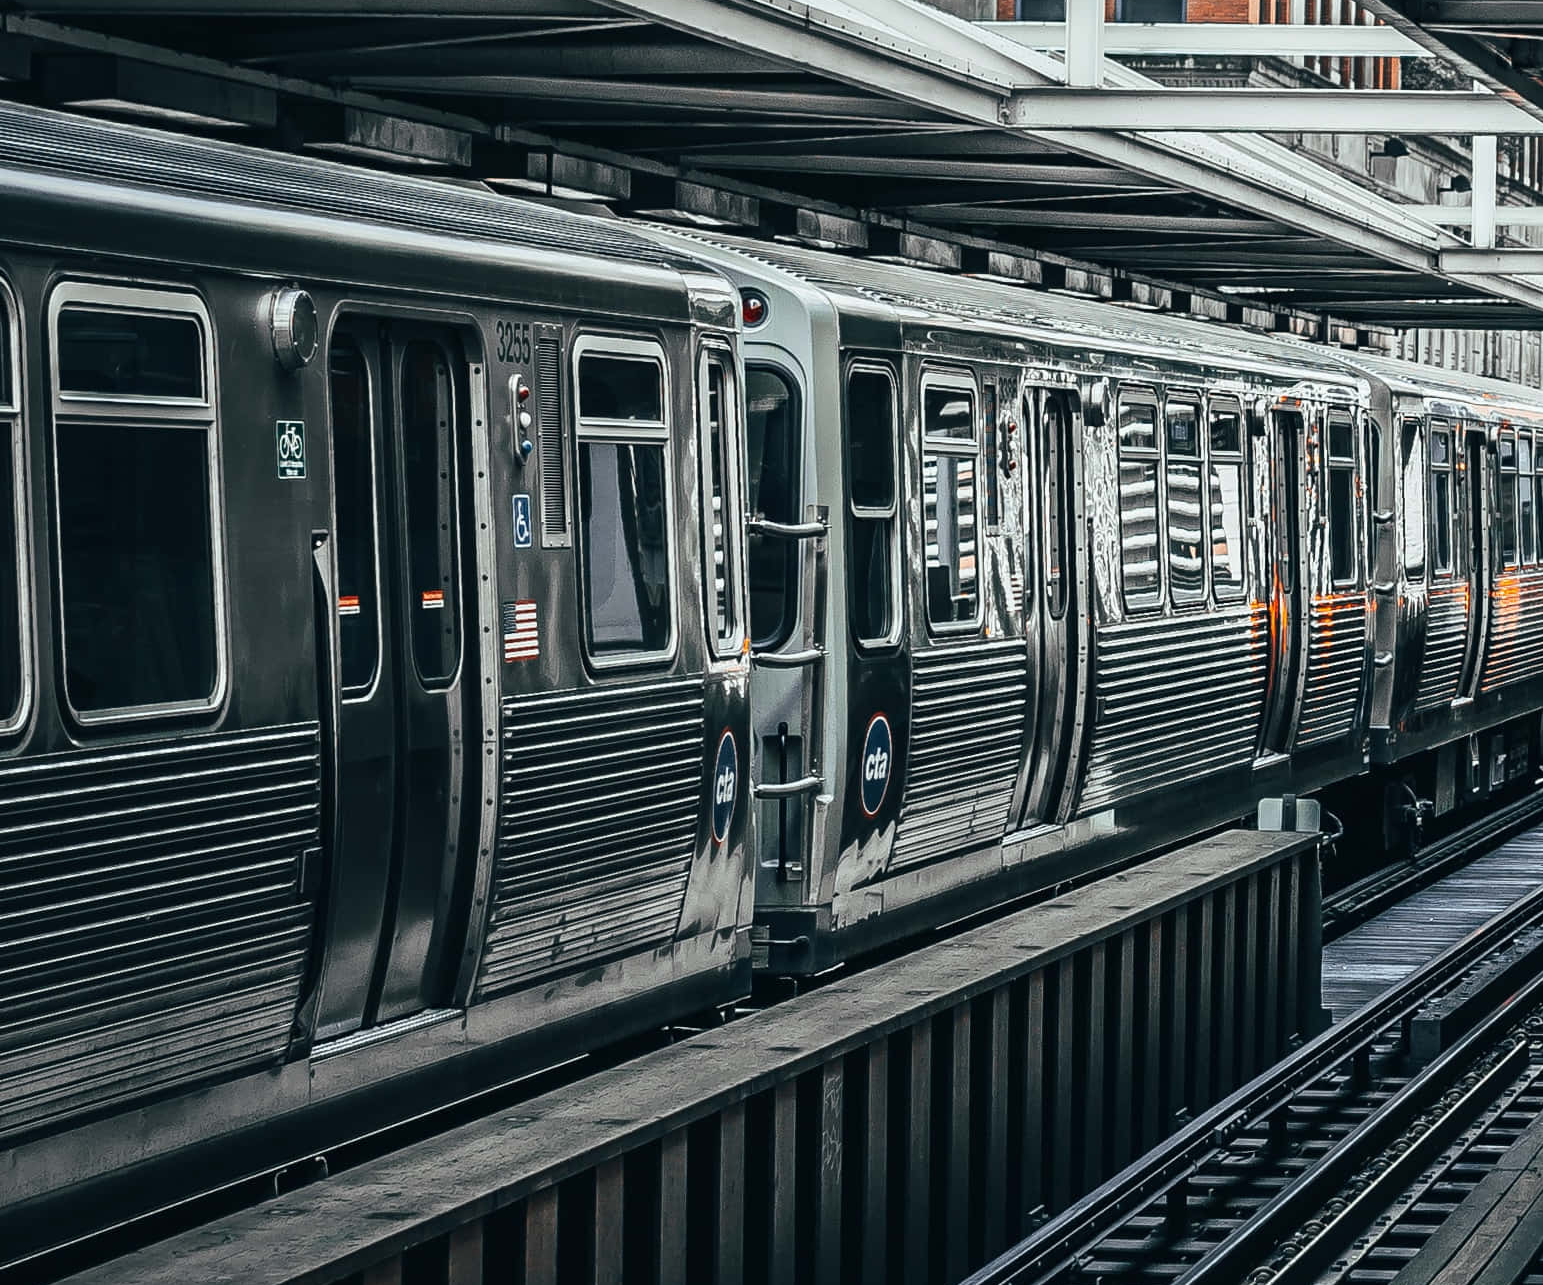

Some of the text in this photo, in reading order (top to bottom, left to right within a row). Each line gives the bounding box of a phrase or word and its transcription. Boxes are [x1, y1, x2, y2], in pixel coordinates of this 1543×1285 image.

[496, 320, 531, 364] 3255
[865, 747, 888, 781] cta
[716, 767, 735, 805] cta
